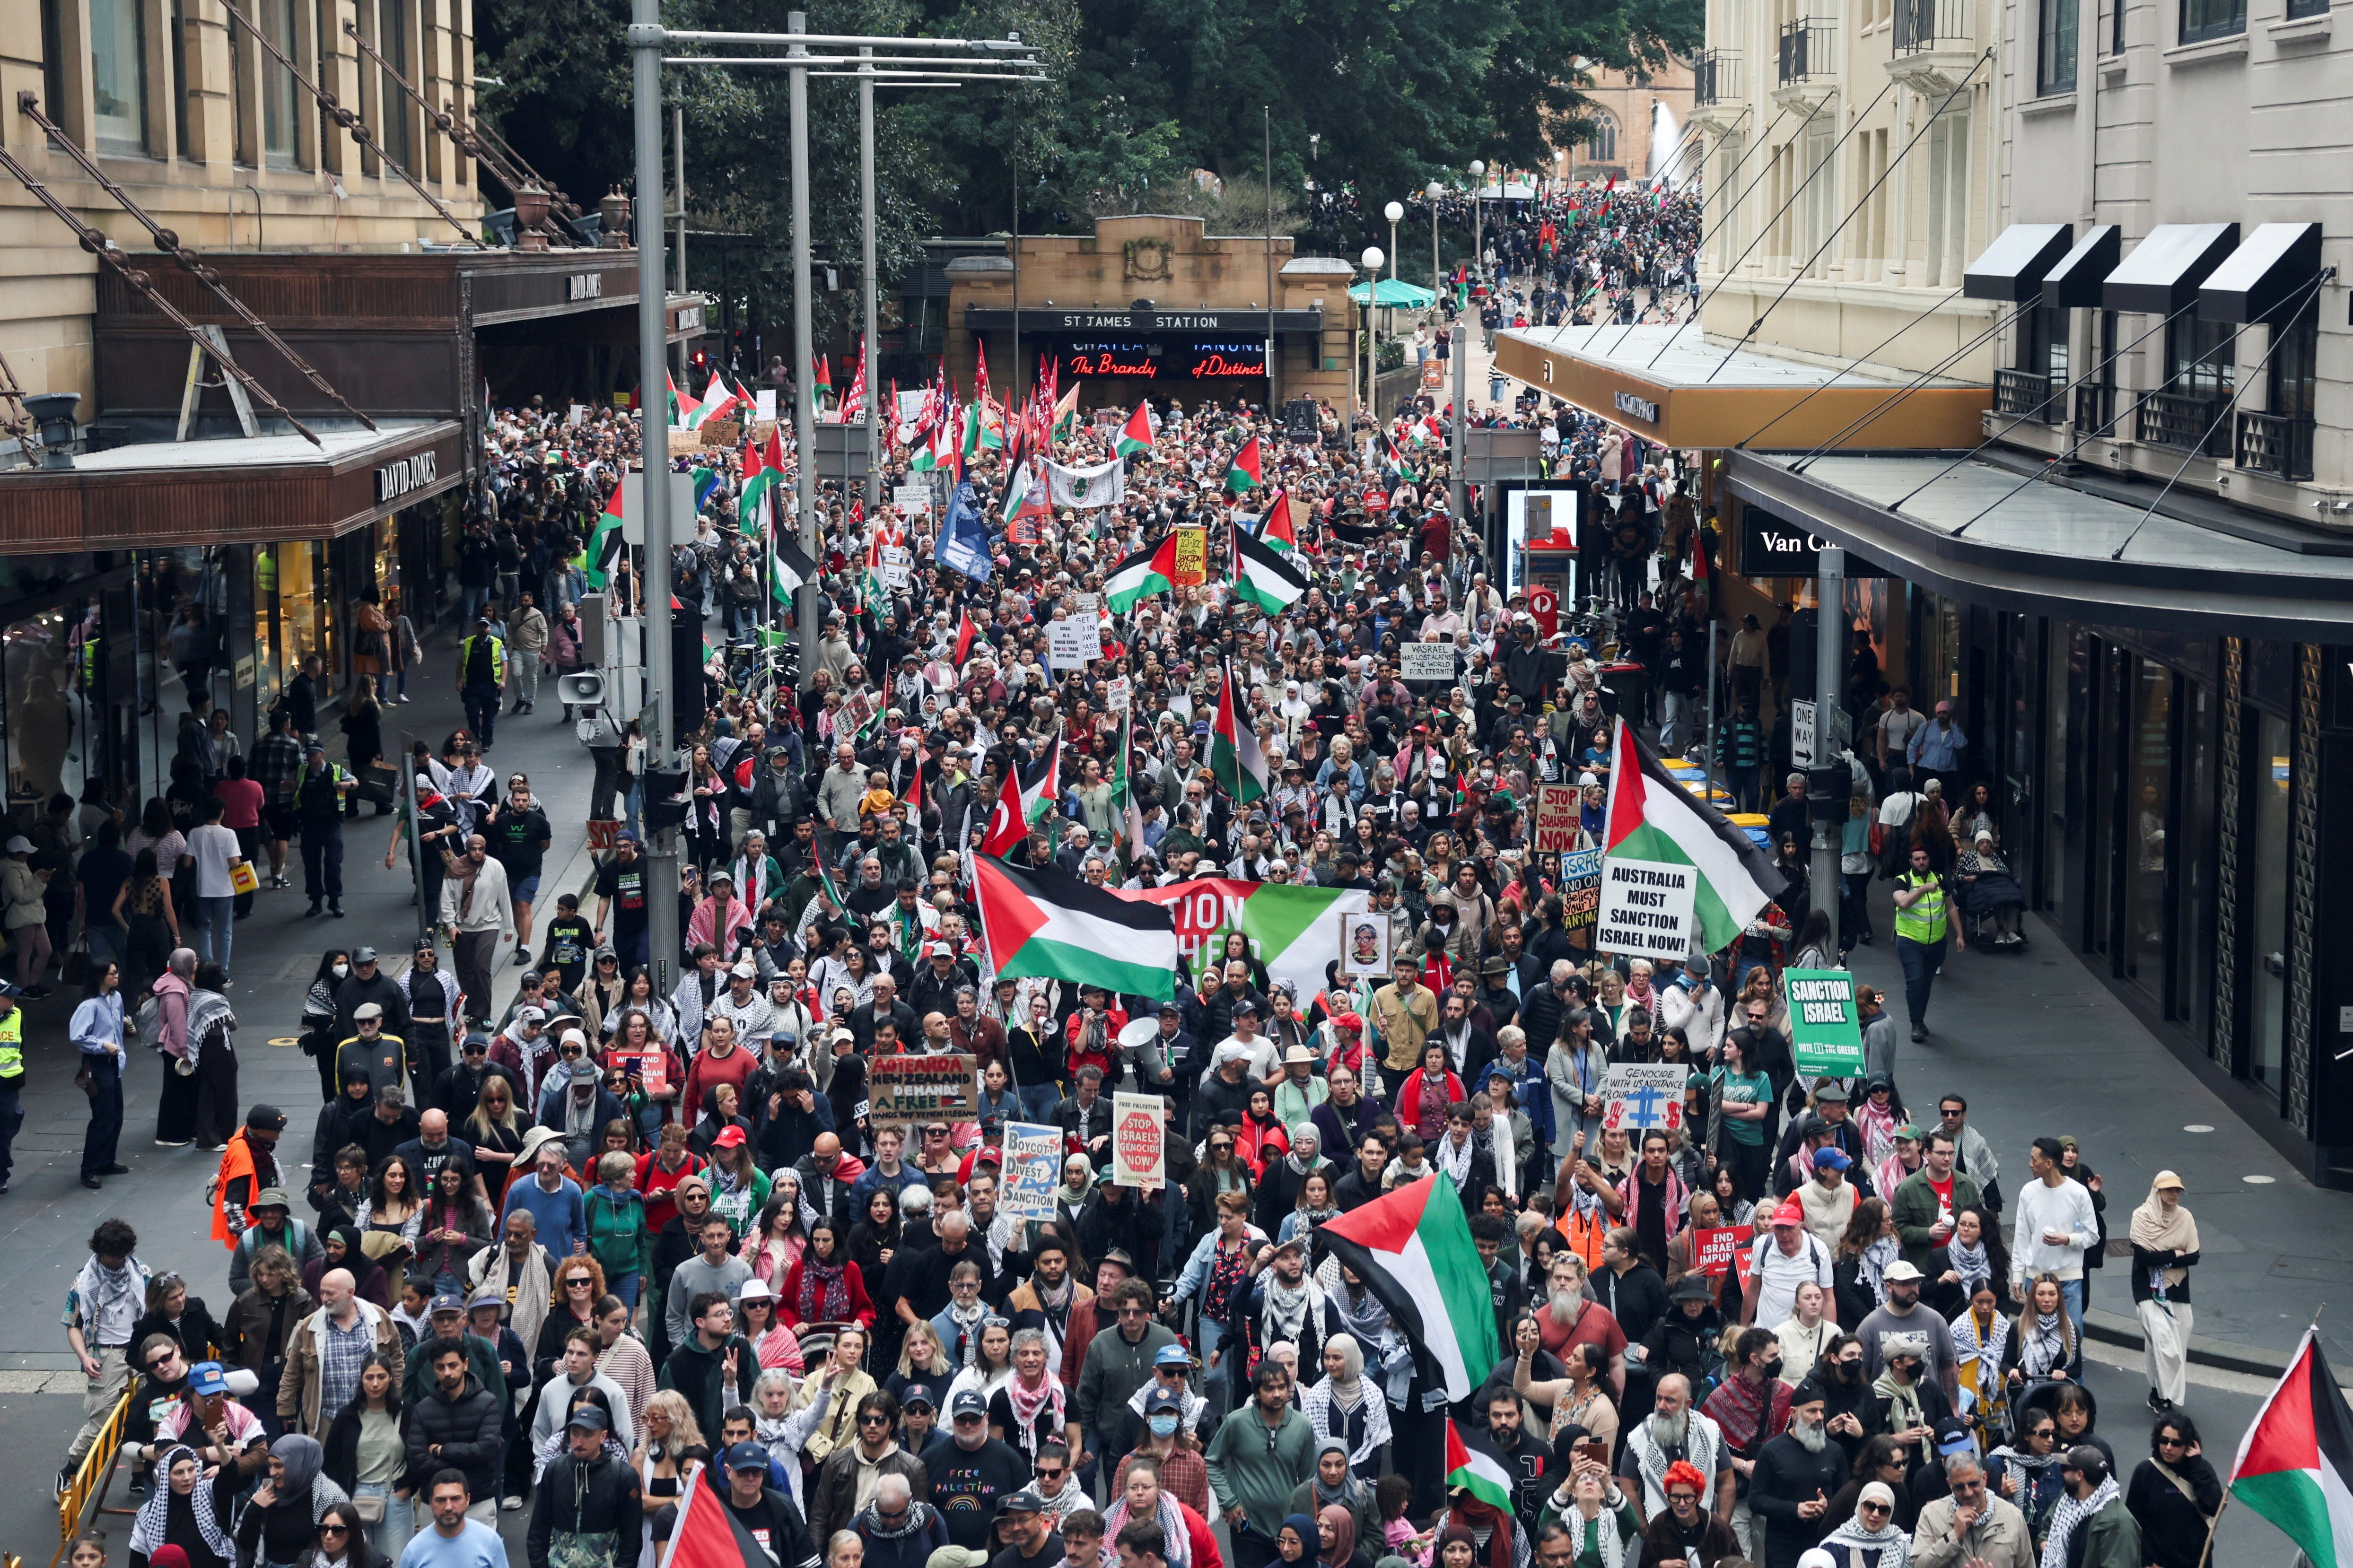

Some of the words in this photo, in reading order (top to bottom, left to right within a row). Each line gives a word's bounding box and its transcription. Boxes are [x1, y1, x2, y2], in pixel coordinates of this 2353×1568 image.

[571, 275, 586, 300] DAVID
[586, 273, 601, 298] JONES
[1064, 316, 1083, 327] ST
[1087, 316, 1131, 327] JAMES
[1156, 316, 1217, 327] STATION
[1071, 357, 1093, 374] The
[1098, 353, 1156, 378] Brandy
[1192, 360, 1207, 378] of
[713, 422, 734, 430] STOP
[675, 432, 699, 441] FREE
[701, 436, 737, 446] GENOCIDE
[382, 461, 409, 501] DAVID
[410, 451, 436, 490] JONES
[1761, 532, 1801, 552] Van
[1178, 554, 1202, 563] SANCTION
[1411, 645, 1448, 653] WASRAEL
[1110, 679, 1125, 691] STOP
[1111, 689, 1127, 698] APARTHEID
[843, 710, 853, 732] ISRAEL
[1796, 707, 1812, 724] ONE
[838, 714, 849, 735] NOW
[1795, 727, 1813, 745] WAY
[682, 756, 691, 770] ONE
[1545, 788, 1577, 806] STOP
[1553, 806, 1568, 814] THE
[1538, 813, 1579, 830] SLAUGHTER
[590, 820, 621, 849] SOS
[1539, 830, 1576, 851] NOW
[1565, 880, 1581, 892] NO
[1584, 874, 1600, 888] ON
[1612, 867, 1685, 889] AUSTRALIA
[1627, 890, 1666, 907] MUST
[1610, 909, 1678, 930] SANCTION
[554, 927, 578, 936] BATMAN
[1600, 928, 1644, 948] ISRAEL
[1647, 934, 1685, 952] NOW!
[1791, 981, 1850, 1001] SANCTION
[1803, 1002, 1846, 1023] ISRAEL
[1798, 1043, 1813, 1053] VOTE
[1824, 1044, 1836, 1054] THE
[1837, 1045, 1859, 1055] GREENS
[871, 1056, 963, 1073] AOTEAROA
[872, 1073, 903, 1086] NEW
[904, 1073, 971, 1085] ZEALAND
[1625, 1068, 1676, 1079] GENOCIDE
[893, 1084, 961, 1096] DEMANDS
[1610, 1079, 1631, 1088] WITH
[1633, 1079, 1644, 1088] US
[1645, 1079, 1685, 1089] ASSISTANCE
[875, 1096, 891, 1109] A
[894, 1095, 937, 1109] FREE
[1132, 1102, 1160, 1111] PALESTINE
[872, 1111, 898, 1119] HANDS
[1128, 1118, 1151, 1129] STOP
[1008, 1132, 1055, 1155] BOYCOTT
[1119, 1130, 1159, 1143] ISRAEL'S
[1120, 1142, 1159, 1153] GENOCIDE
[1006, 1156, 1042, 1178] DIVEST
[1127, 1155, 1153, 1167] NOW!
[721, 1198, 734, 1206] THE
[1003, 1183, 1053, 1207] SANCTION
[1714, 1232, 1733, 1243] END
[1700, 1252, 1733, 1264] IMPUN
